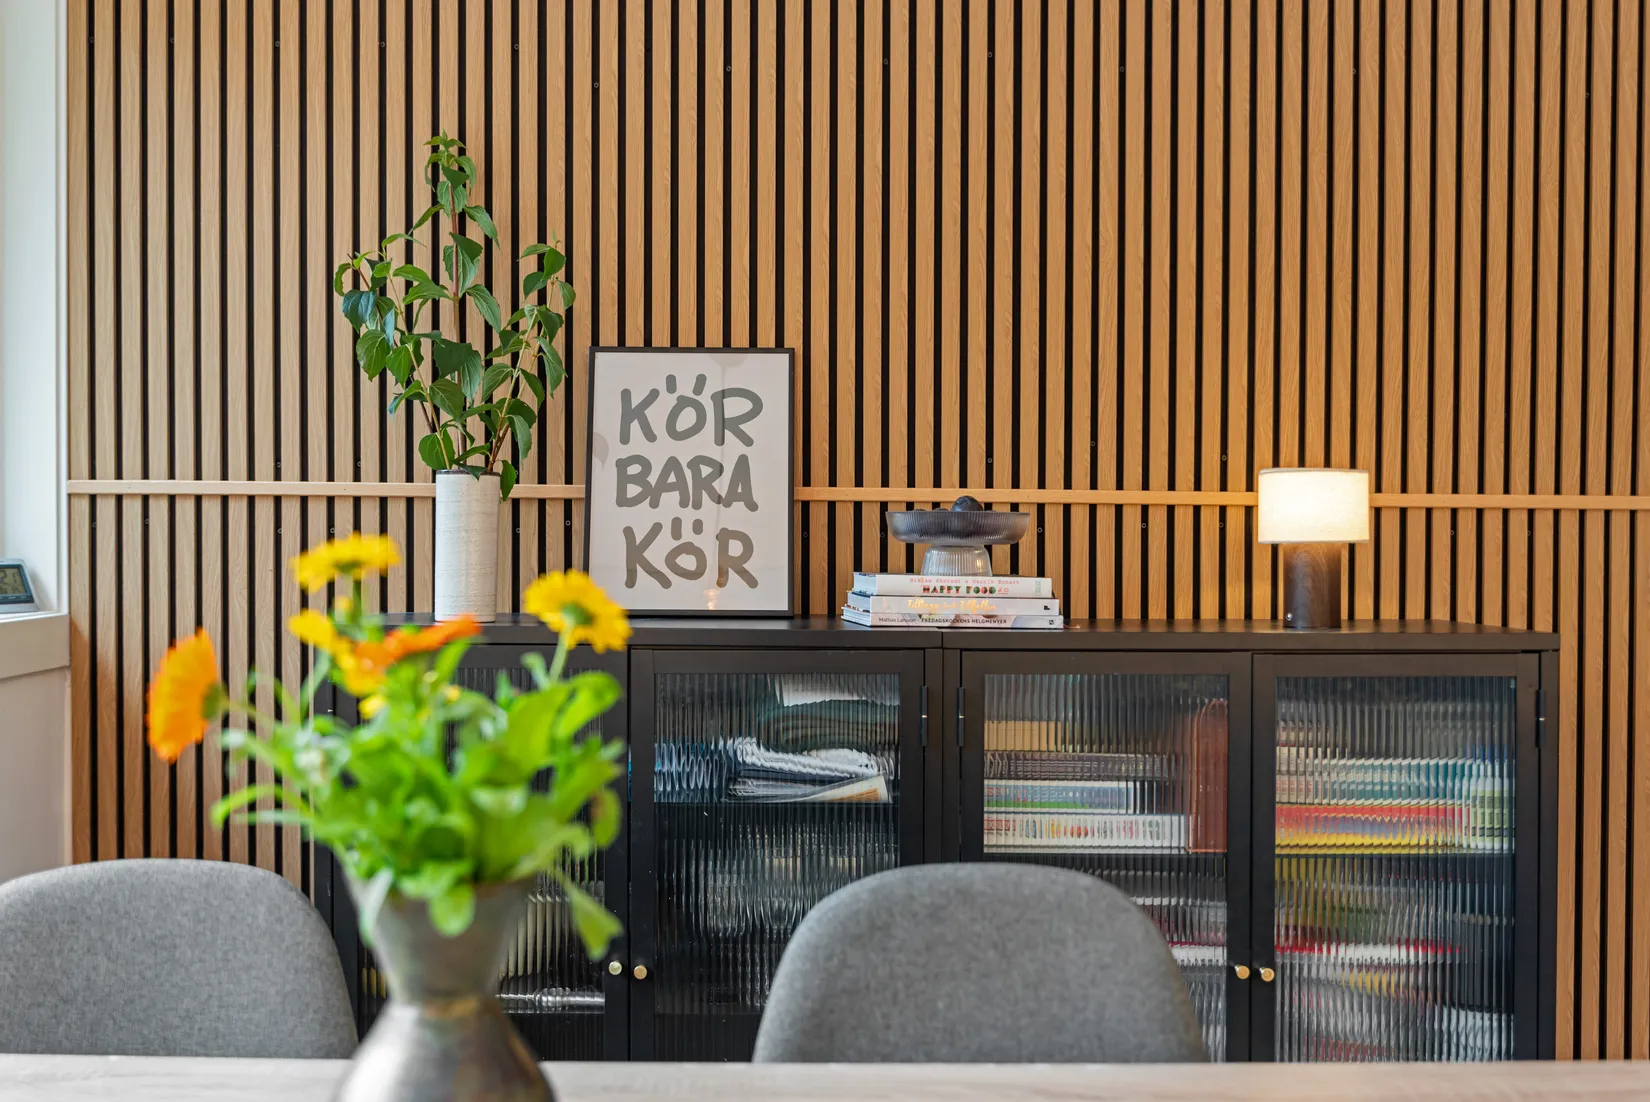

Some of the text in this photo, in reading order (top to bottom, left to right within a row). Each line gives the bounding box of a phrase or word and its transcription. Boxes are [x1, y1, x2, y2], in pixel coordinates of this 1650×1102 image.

[619, 373, 763, 447] KÖR
[615, 453, 759, 512] BARA
[622, 516, 759, 589] KÖR
[922, 585, 961, 594] HAPPY
[965, 585, 996, 594] FOOD
